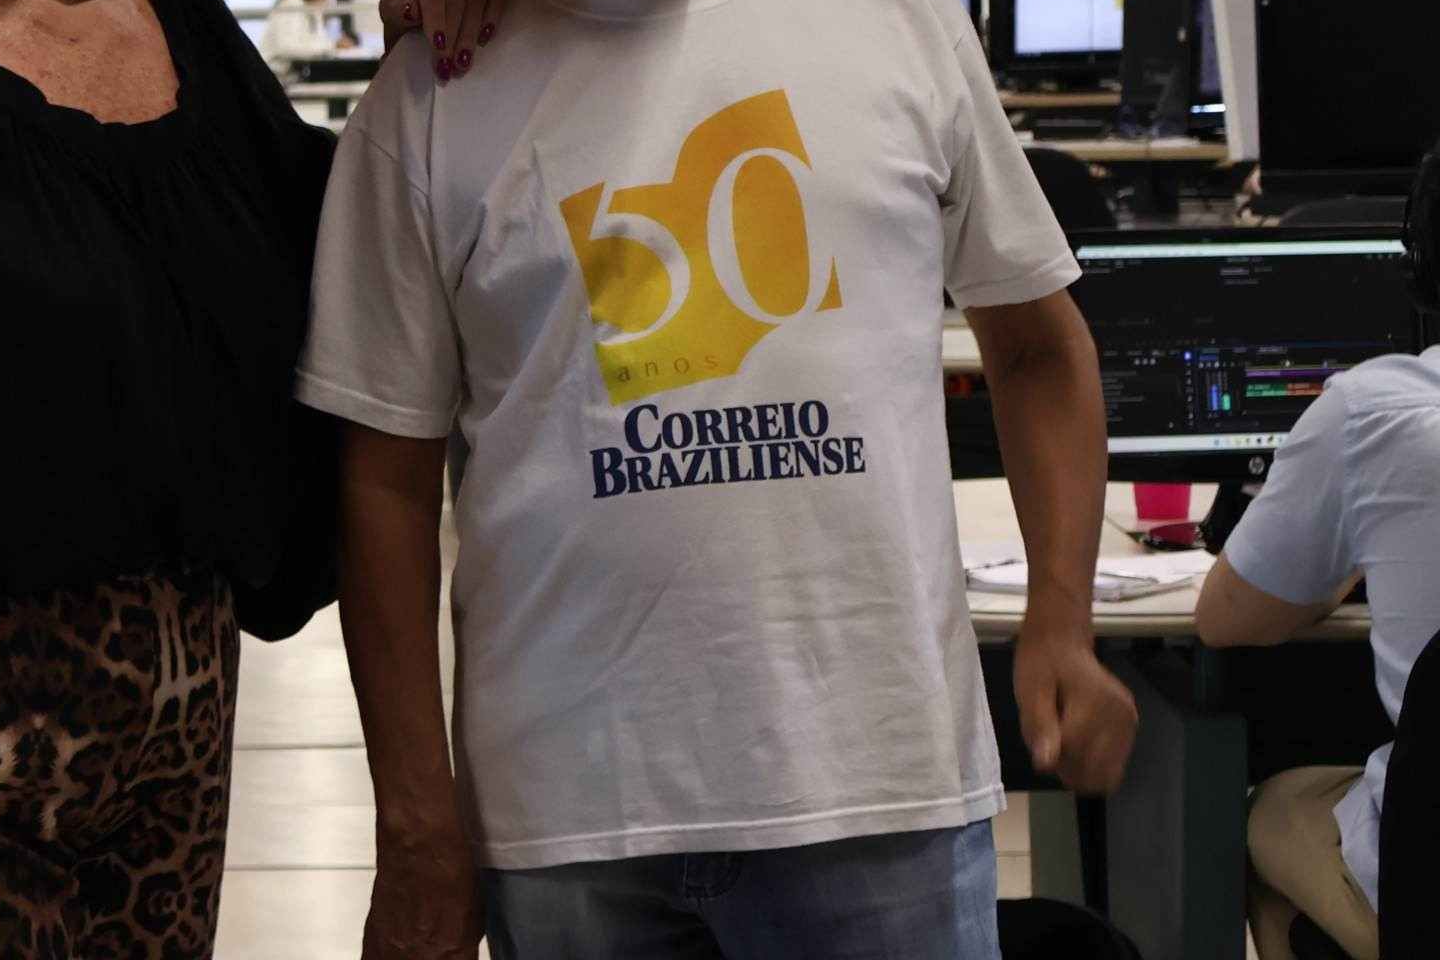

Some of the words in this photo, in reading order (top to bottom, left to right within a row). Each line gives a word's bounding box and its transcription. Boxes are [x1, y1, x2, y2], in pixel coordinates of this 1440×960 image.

[588, 147, 832, 346] 50
[617, 355, 720, 383] anos
[624, 400, 830, 454] CORREIO
[590, 437, 866, 499] BRAZILIENSE
